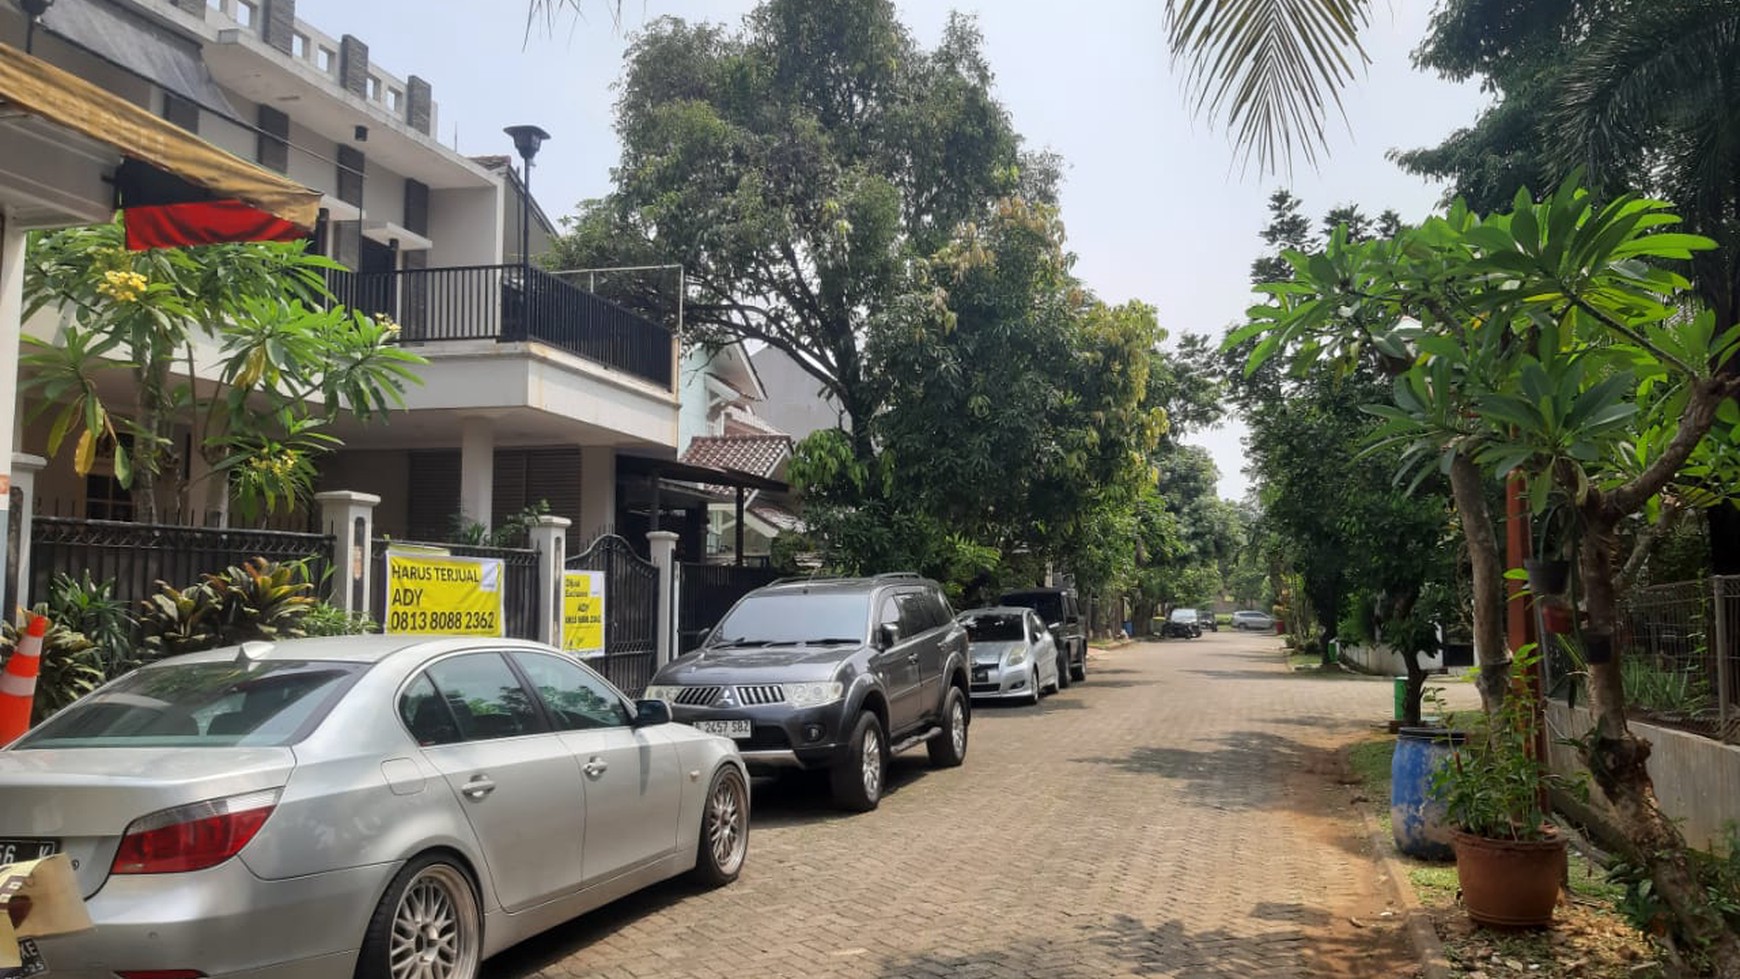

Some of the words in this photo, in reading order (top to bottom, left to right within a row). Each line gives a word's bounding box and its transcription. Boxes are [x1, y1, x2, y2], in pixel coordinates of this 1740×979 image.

[392, 566, 432, 580] HARUS
[434, 568, 479, 583] TERJUAL
[392, 589, 423, 606] ADY
[391, 611, 427, 631] 0813
[429, 611, 463, 631] 8088
[465, 611, 494, 629] 2362
[705, 721, 728, 733] 2457
